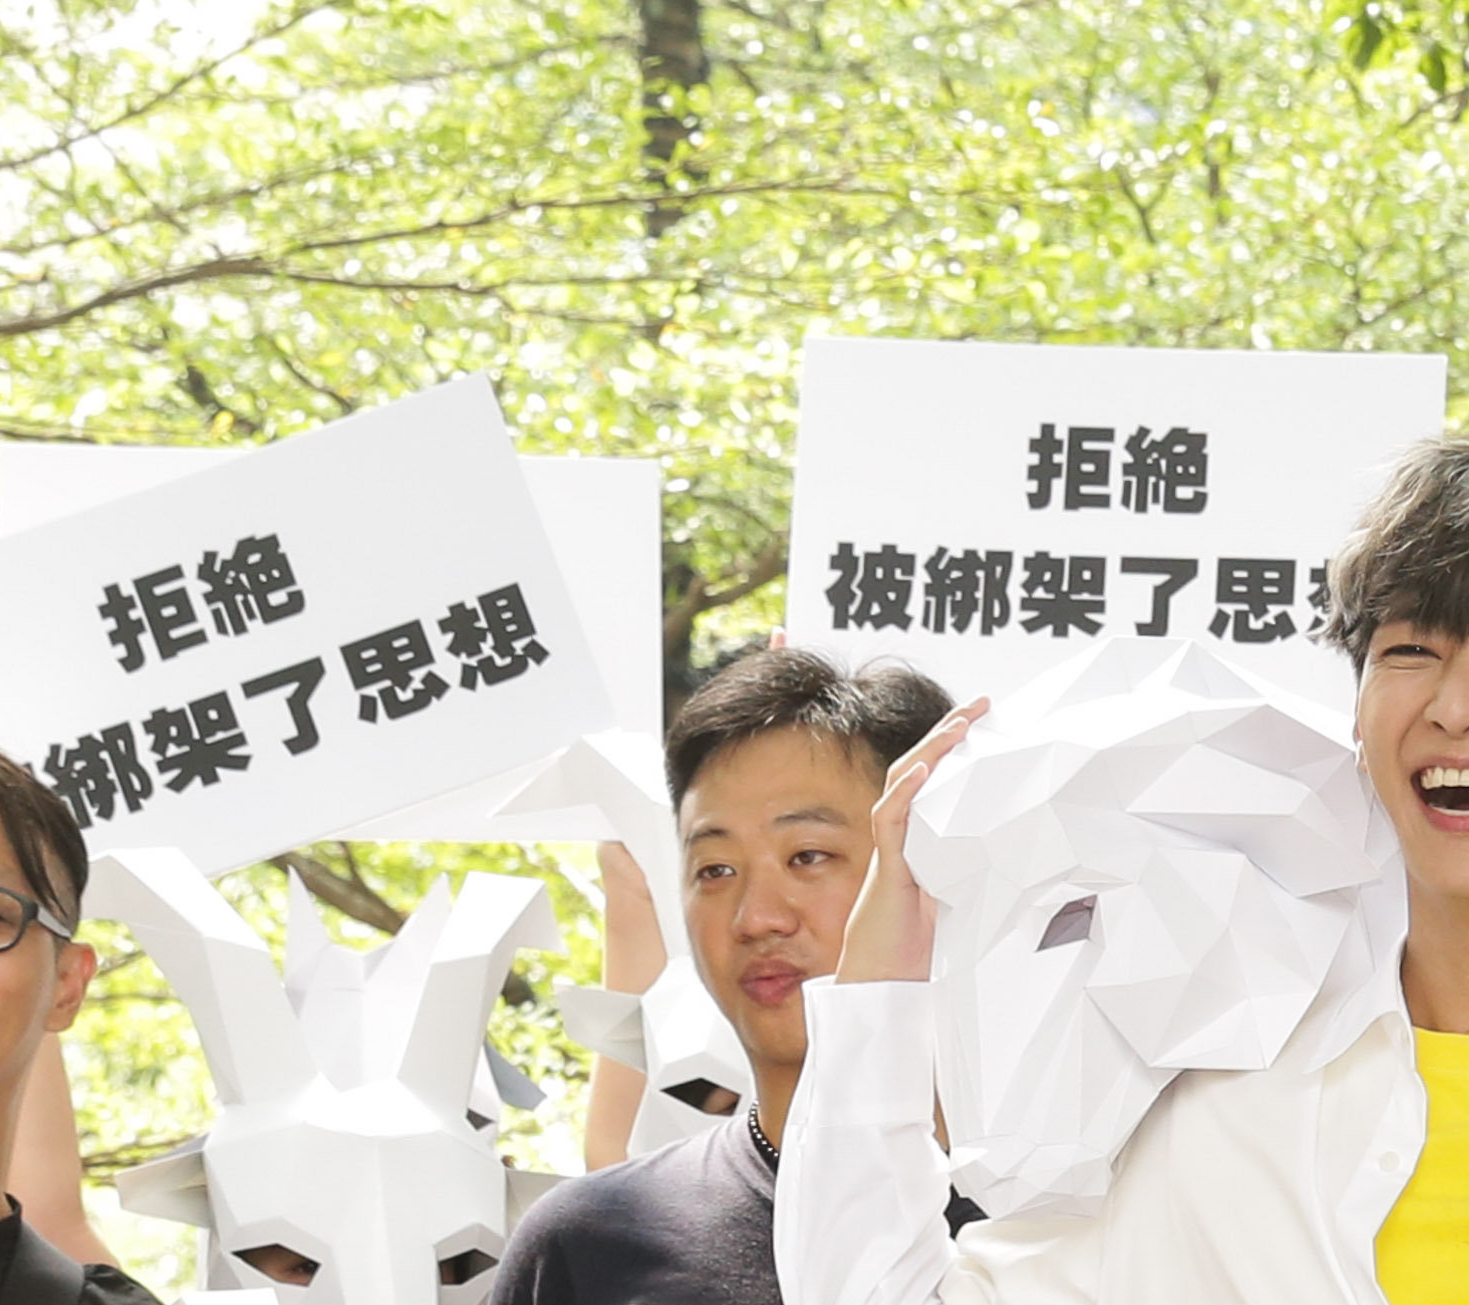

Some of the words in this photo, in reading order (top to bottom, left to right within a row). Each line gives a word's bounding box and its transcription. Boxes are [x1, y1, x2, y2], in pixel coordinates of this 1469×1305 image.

[825, 542, 1333, 644] 被綁架了思
[26, 582, 550, 829] 綁架了思想
